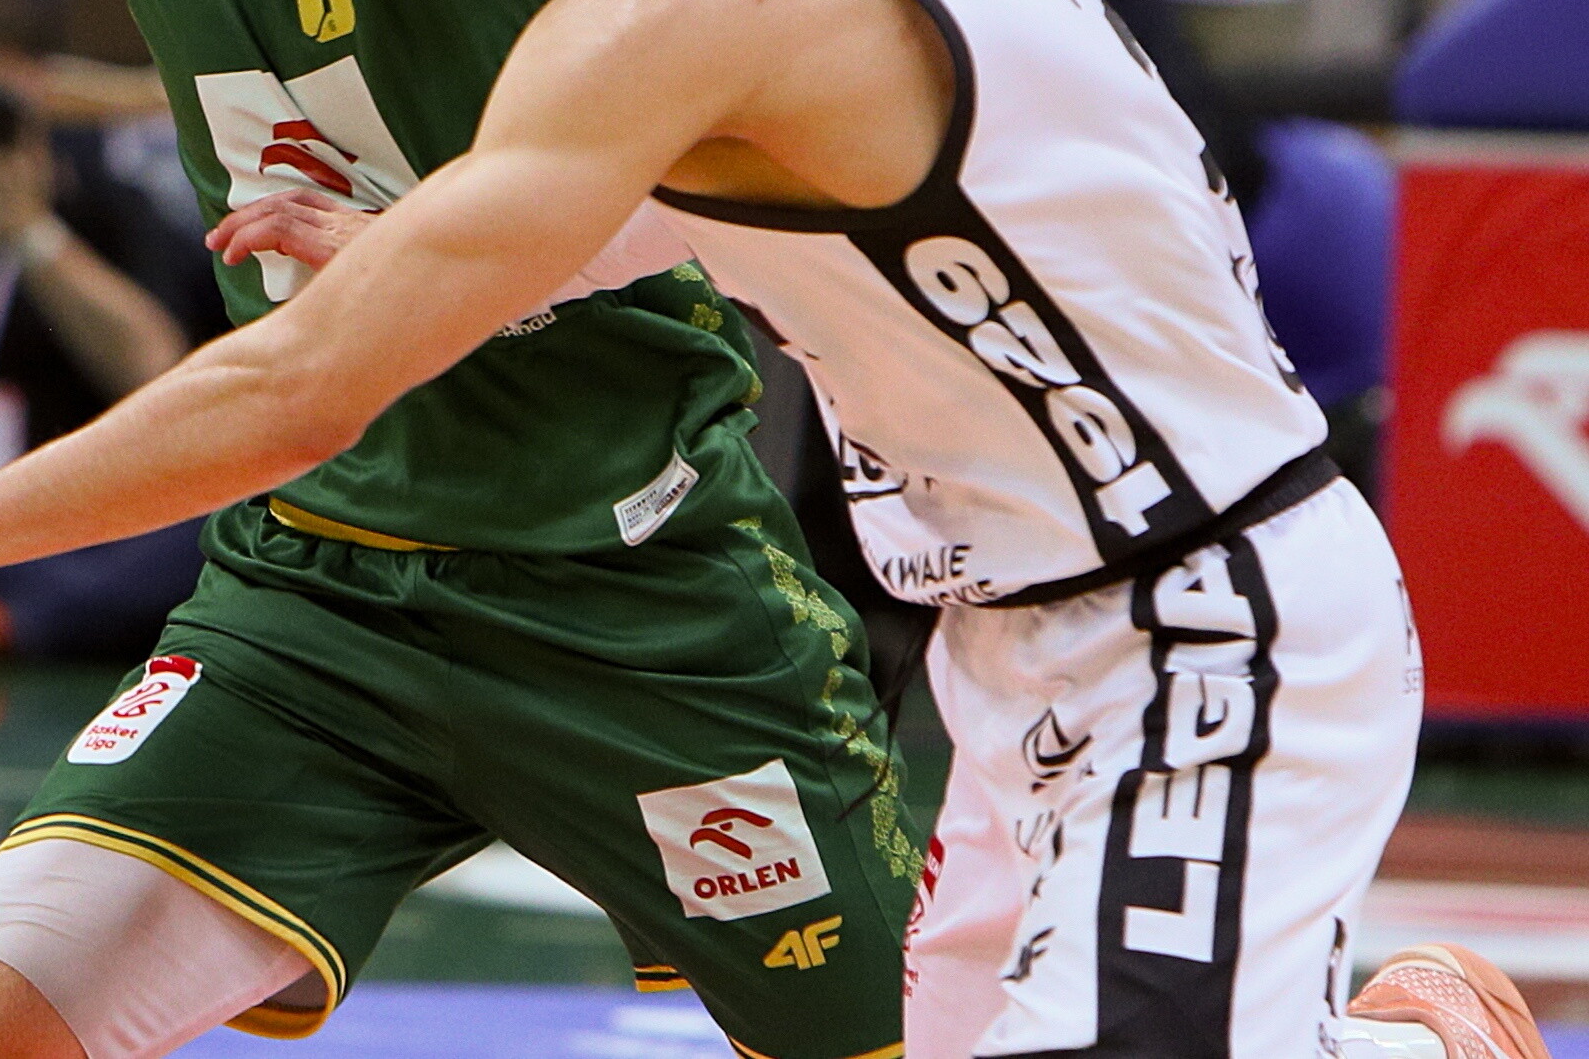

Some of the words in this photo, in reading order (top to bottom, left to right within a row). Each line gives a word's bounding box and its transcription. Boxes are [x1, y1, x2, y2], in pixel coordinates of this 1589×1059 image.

[903, 234, 1173, 538] 1929
[1122, 542, 1259, 964] LEGIA
[693, 857, 802, 899] ORLEN
[763, 914, 843, 971] 4F
